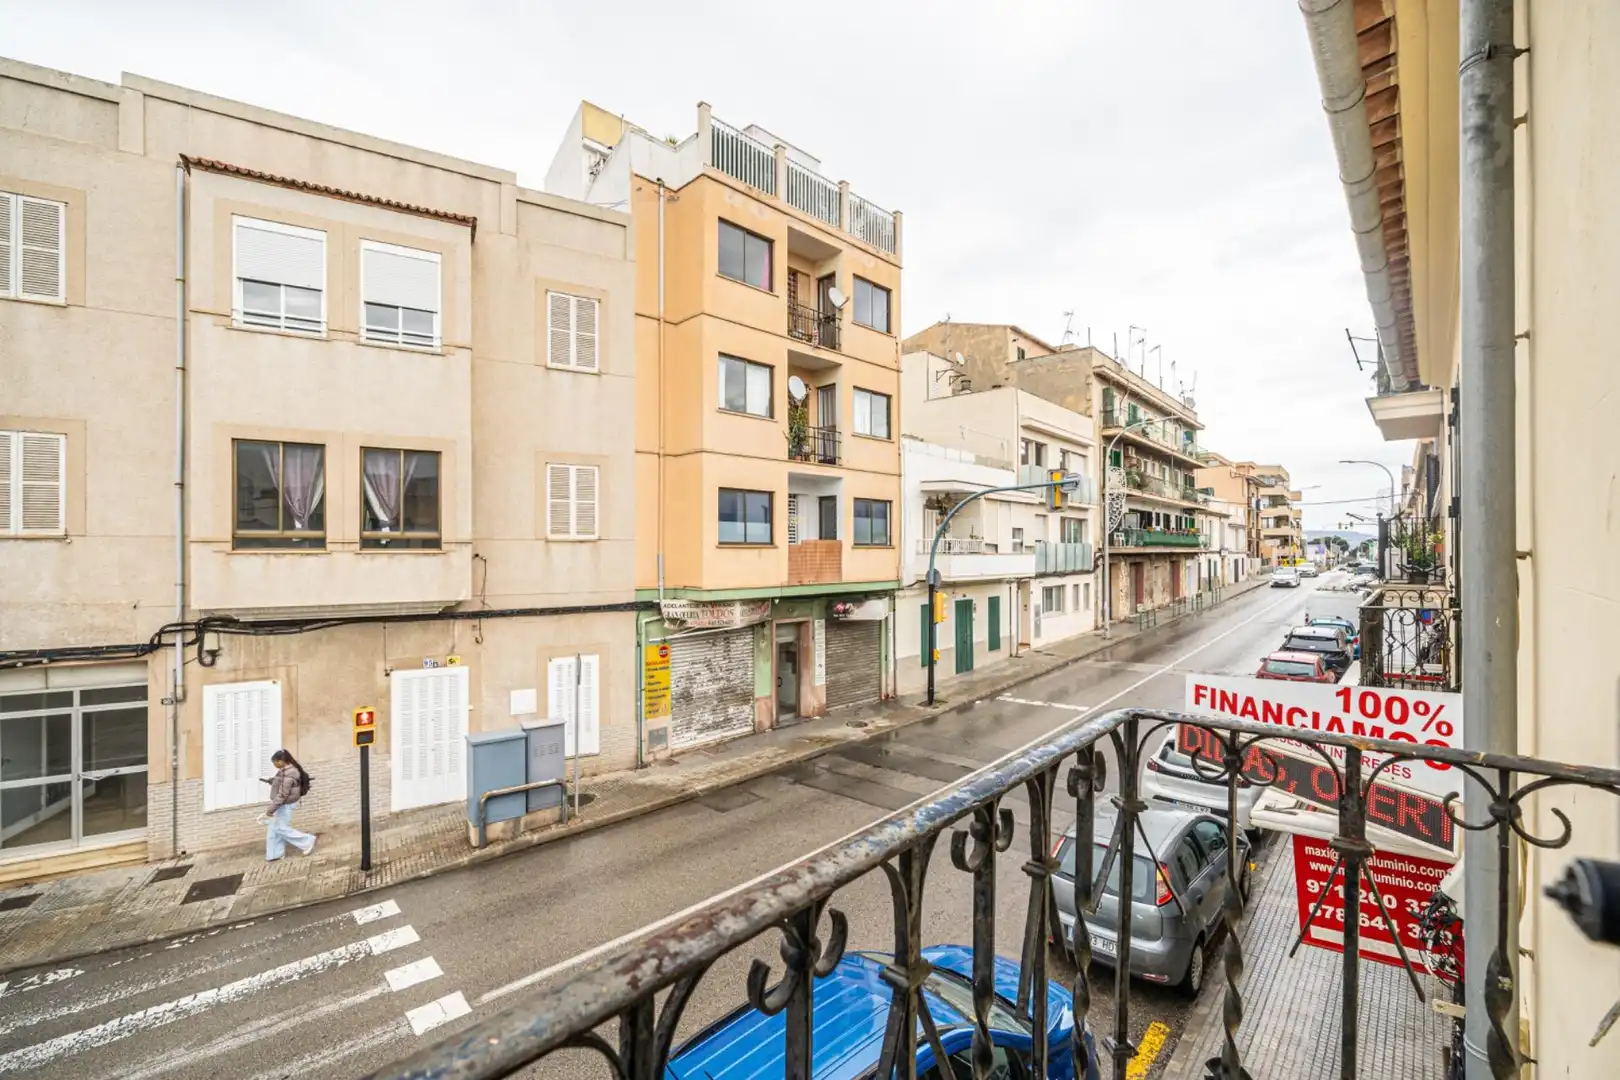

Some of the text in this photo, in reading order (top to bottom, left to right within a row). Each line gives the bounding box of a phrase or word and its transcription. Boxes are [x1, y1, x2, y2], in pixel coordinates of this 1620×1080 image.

[1335, 686, 1454, 737] 100%
[1330, 746, 1412, 780] INRESES
[1311, 766, 1455, 844] OERT
[1305, 845, 1446, 879] maxi@aluminio.com
